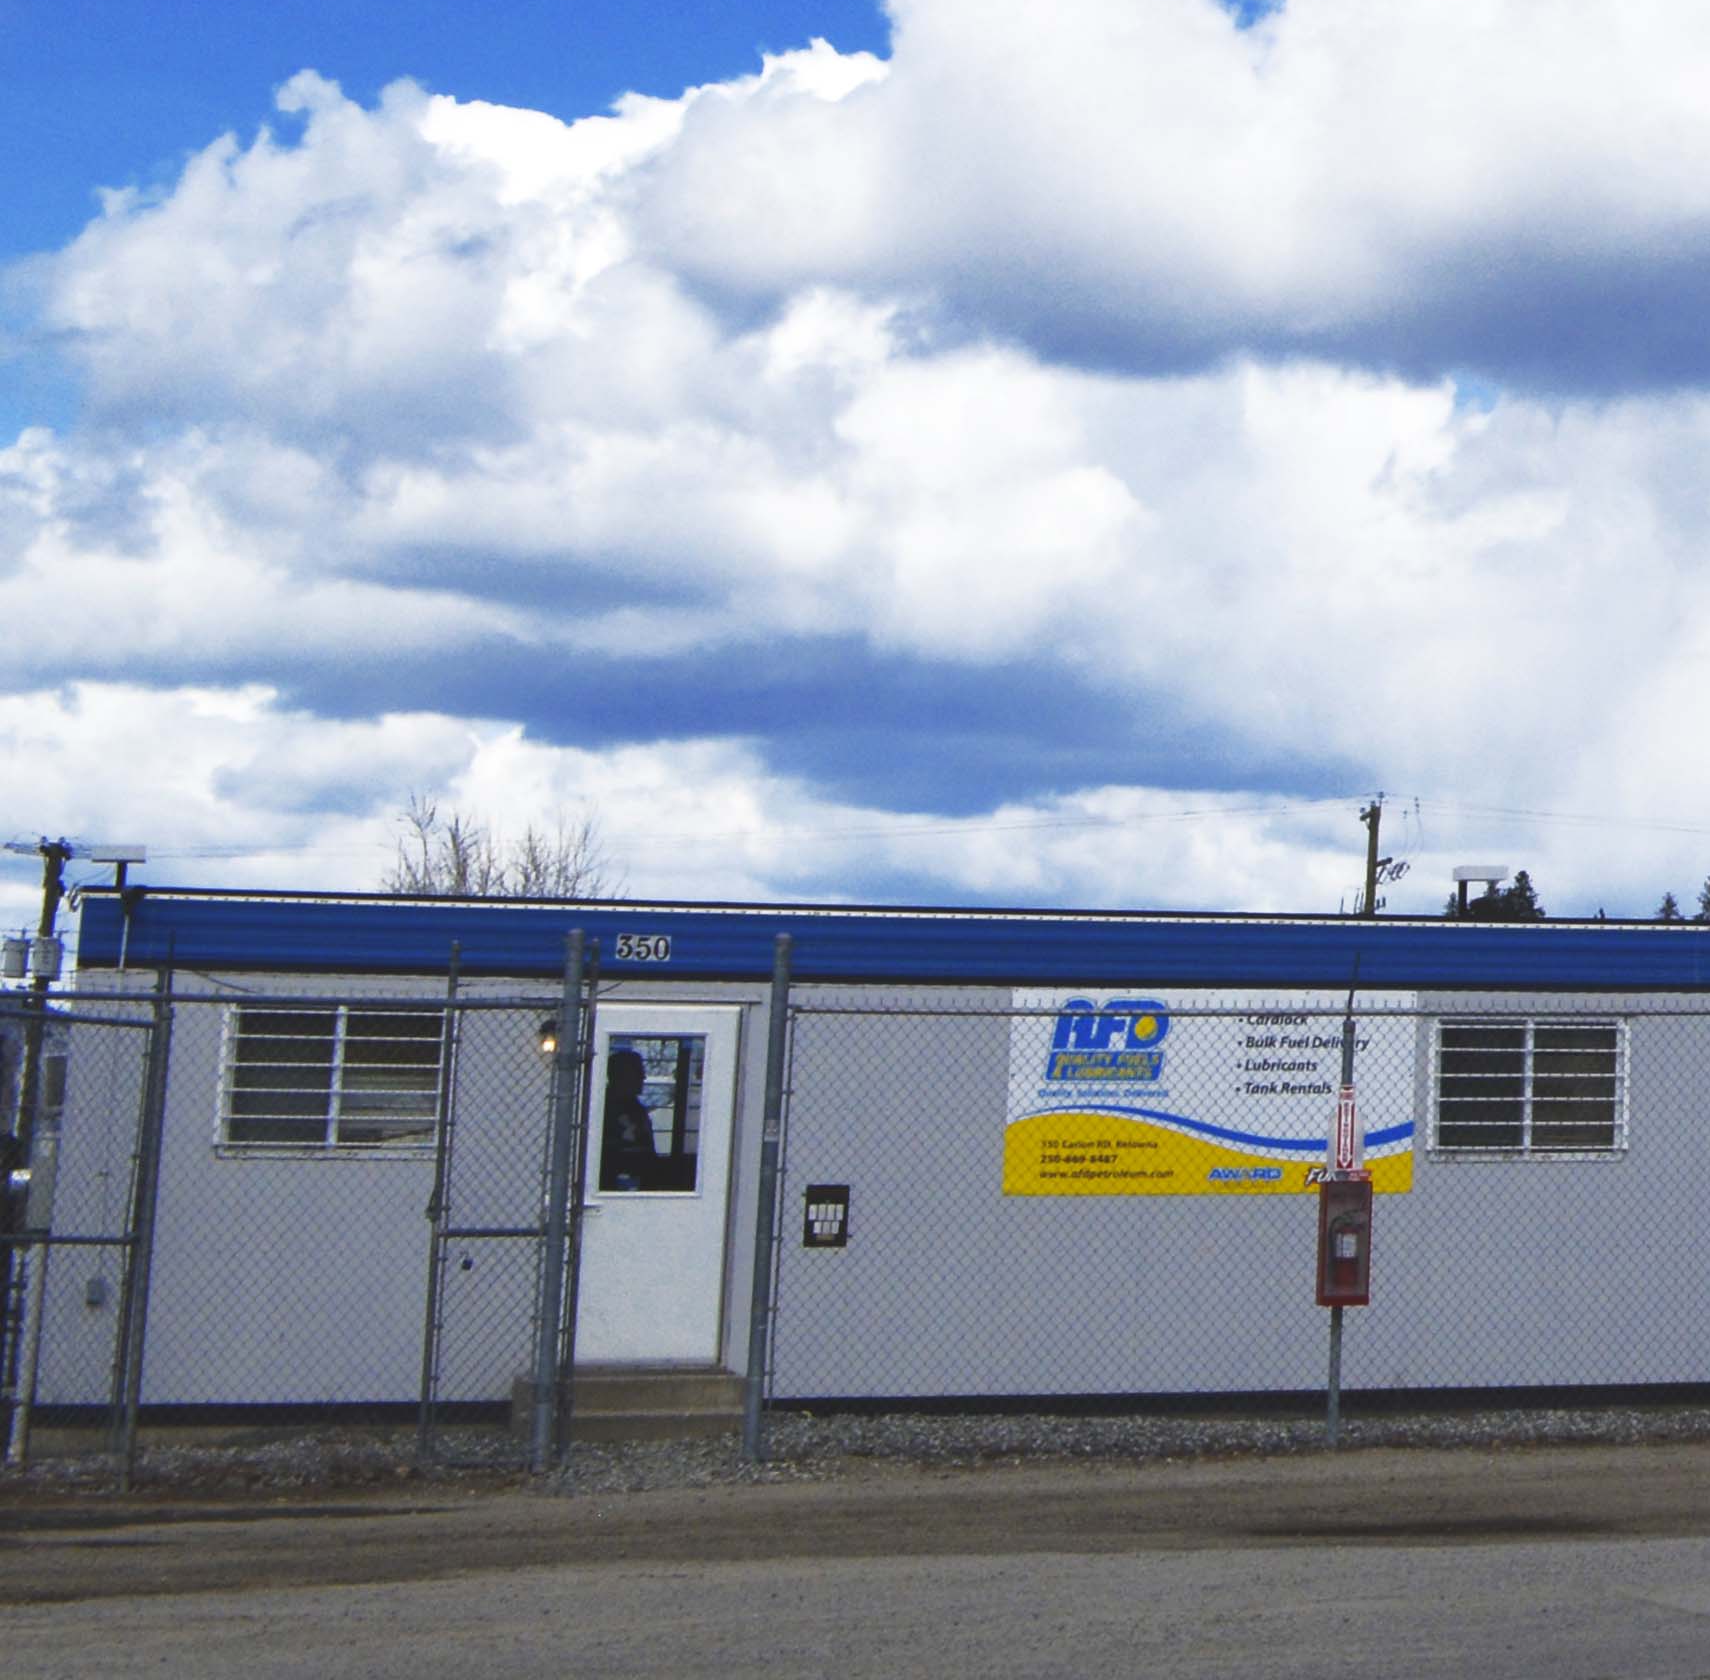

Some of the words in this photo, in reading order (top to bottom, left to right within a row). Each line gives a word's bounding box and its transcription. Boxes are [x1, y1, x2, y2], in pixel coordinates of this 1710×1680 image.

[617, 935, 669, 960] 350
[1245, 1036, 1276, 1049] Bulk
[1279, 1036, 1309, 1049] Fuel
[1312, 1036, 1370, 1052] Delivry
[1244, 1059, 1318, 1071] Lubricants
[1245, 1083, 1278, 1095] Tank
[1280, 1083, 1333, 1095] Rentals
[1208, 1167, 1282, 1180] AWARD
